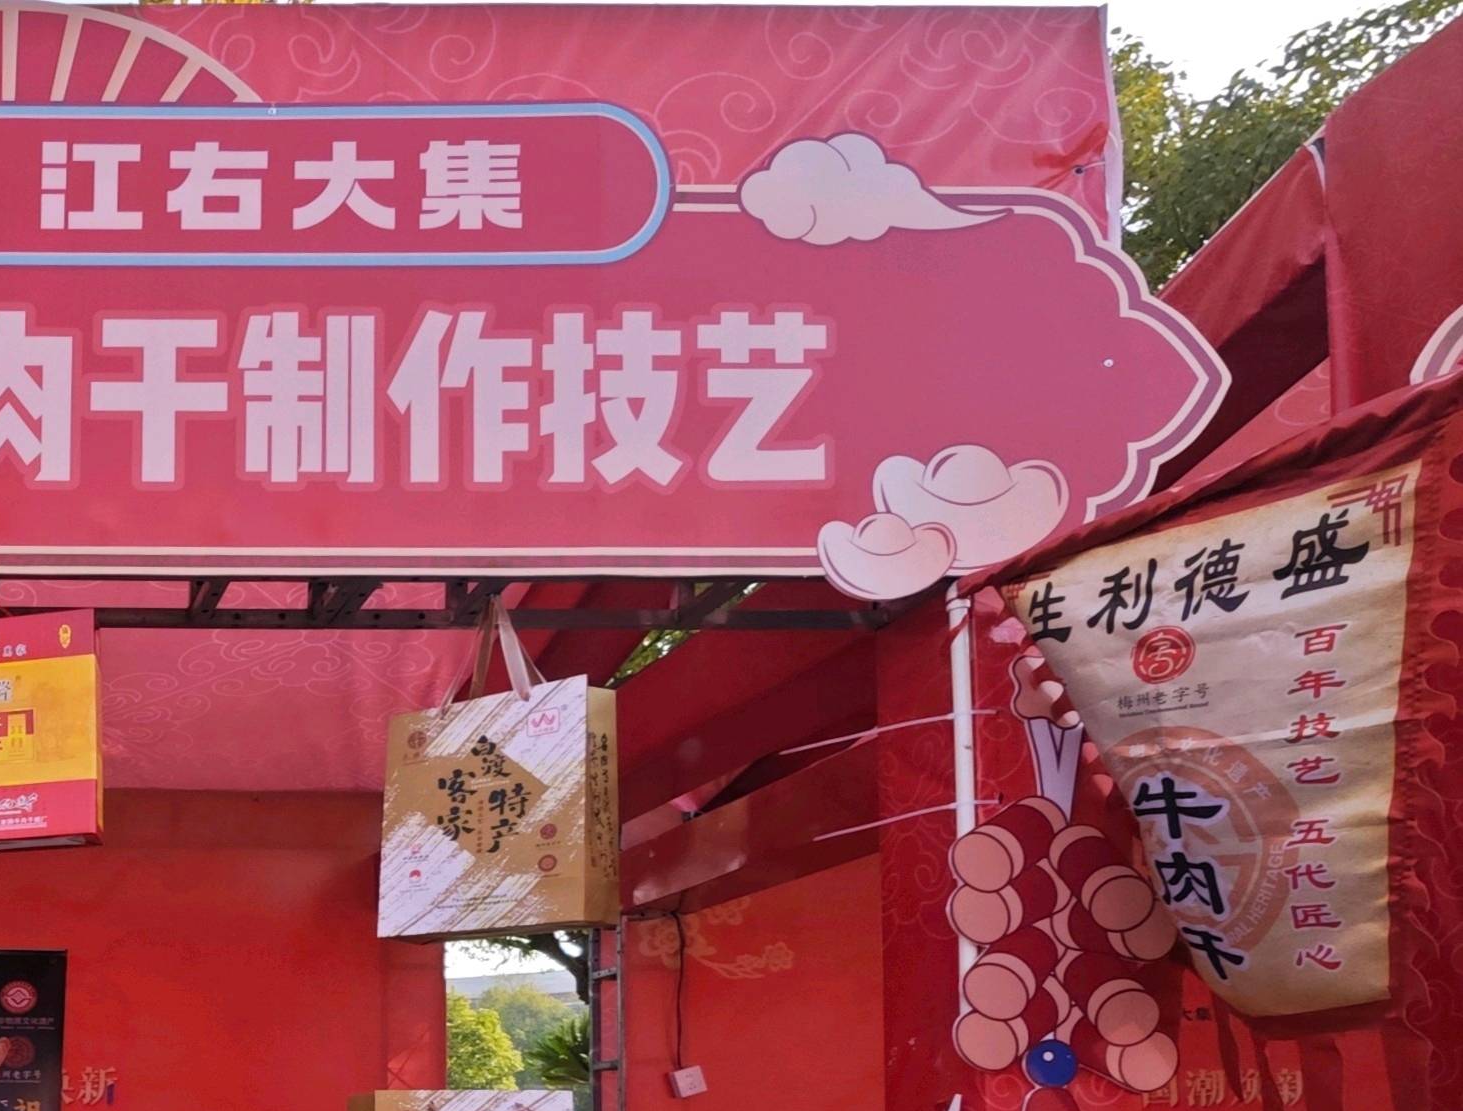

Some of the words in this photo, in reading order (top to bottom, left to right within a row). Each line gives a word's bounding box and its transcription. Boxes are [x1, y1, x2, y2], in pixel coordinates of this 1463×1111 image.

[40, 139, 524, 231] 江右大集
[1025, 508, 1370, 645] 生利德盛
[1116, 683, 1211, 712] 梅州老字号
[1286, 623, 1349, 786] 百年技艺
[1132, 775, 1250, 983] 牛肉干
[1286, 818, 1344, 973] 五代匠心
